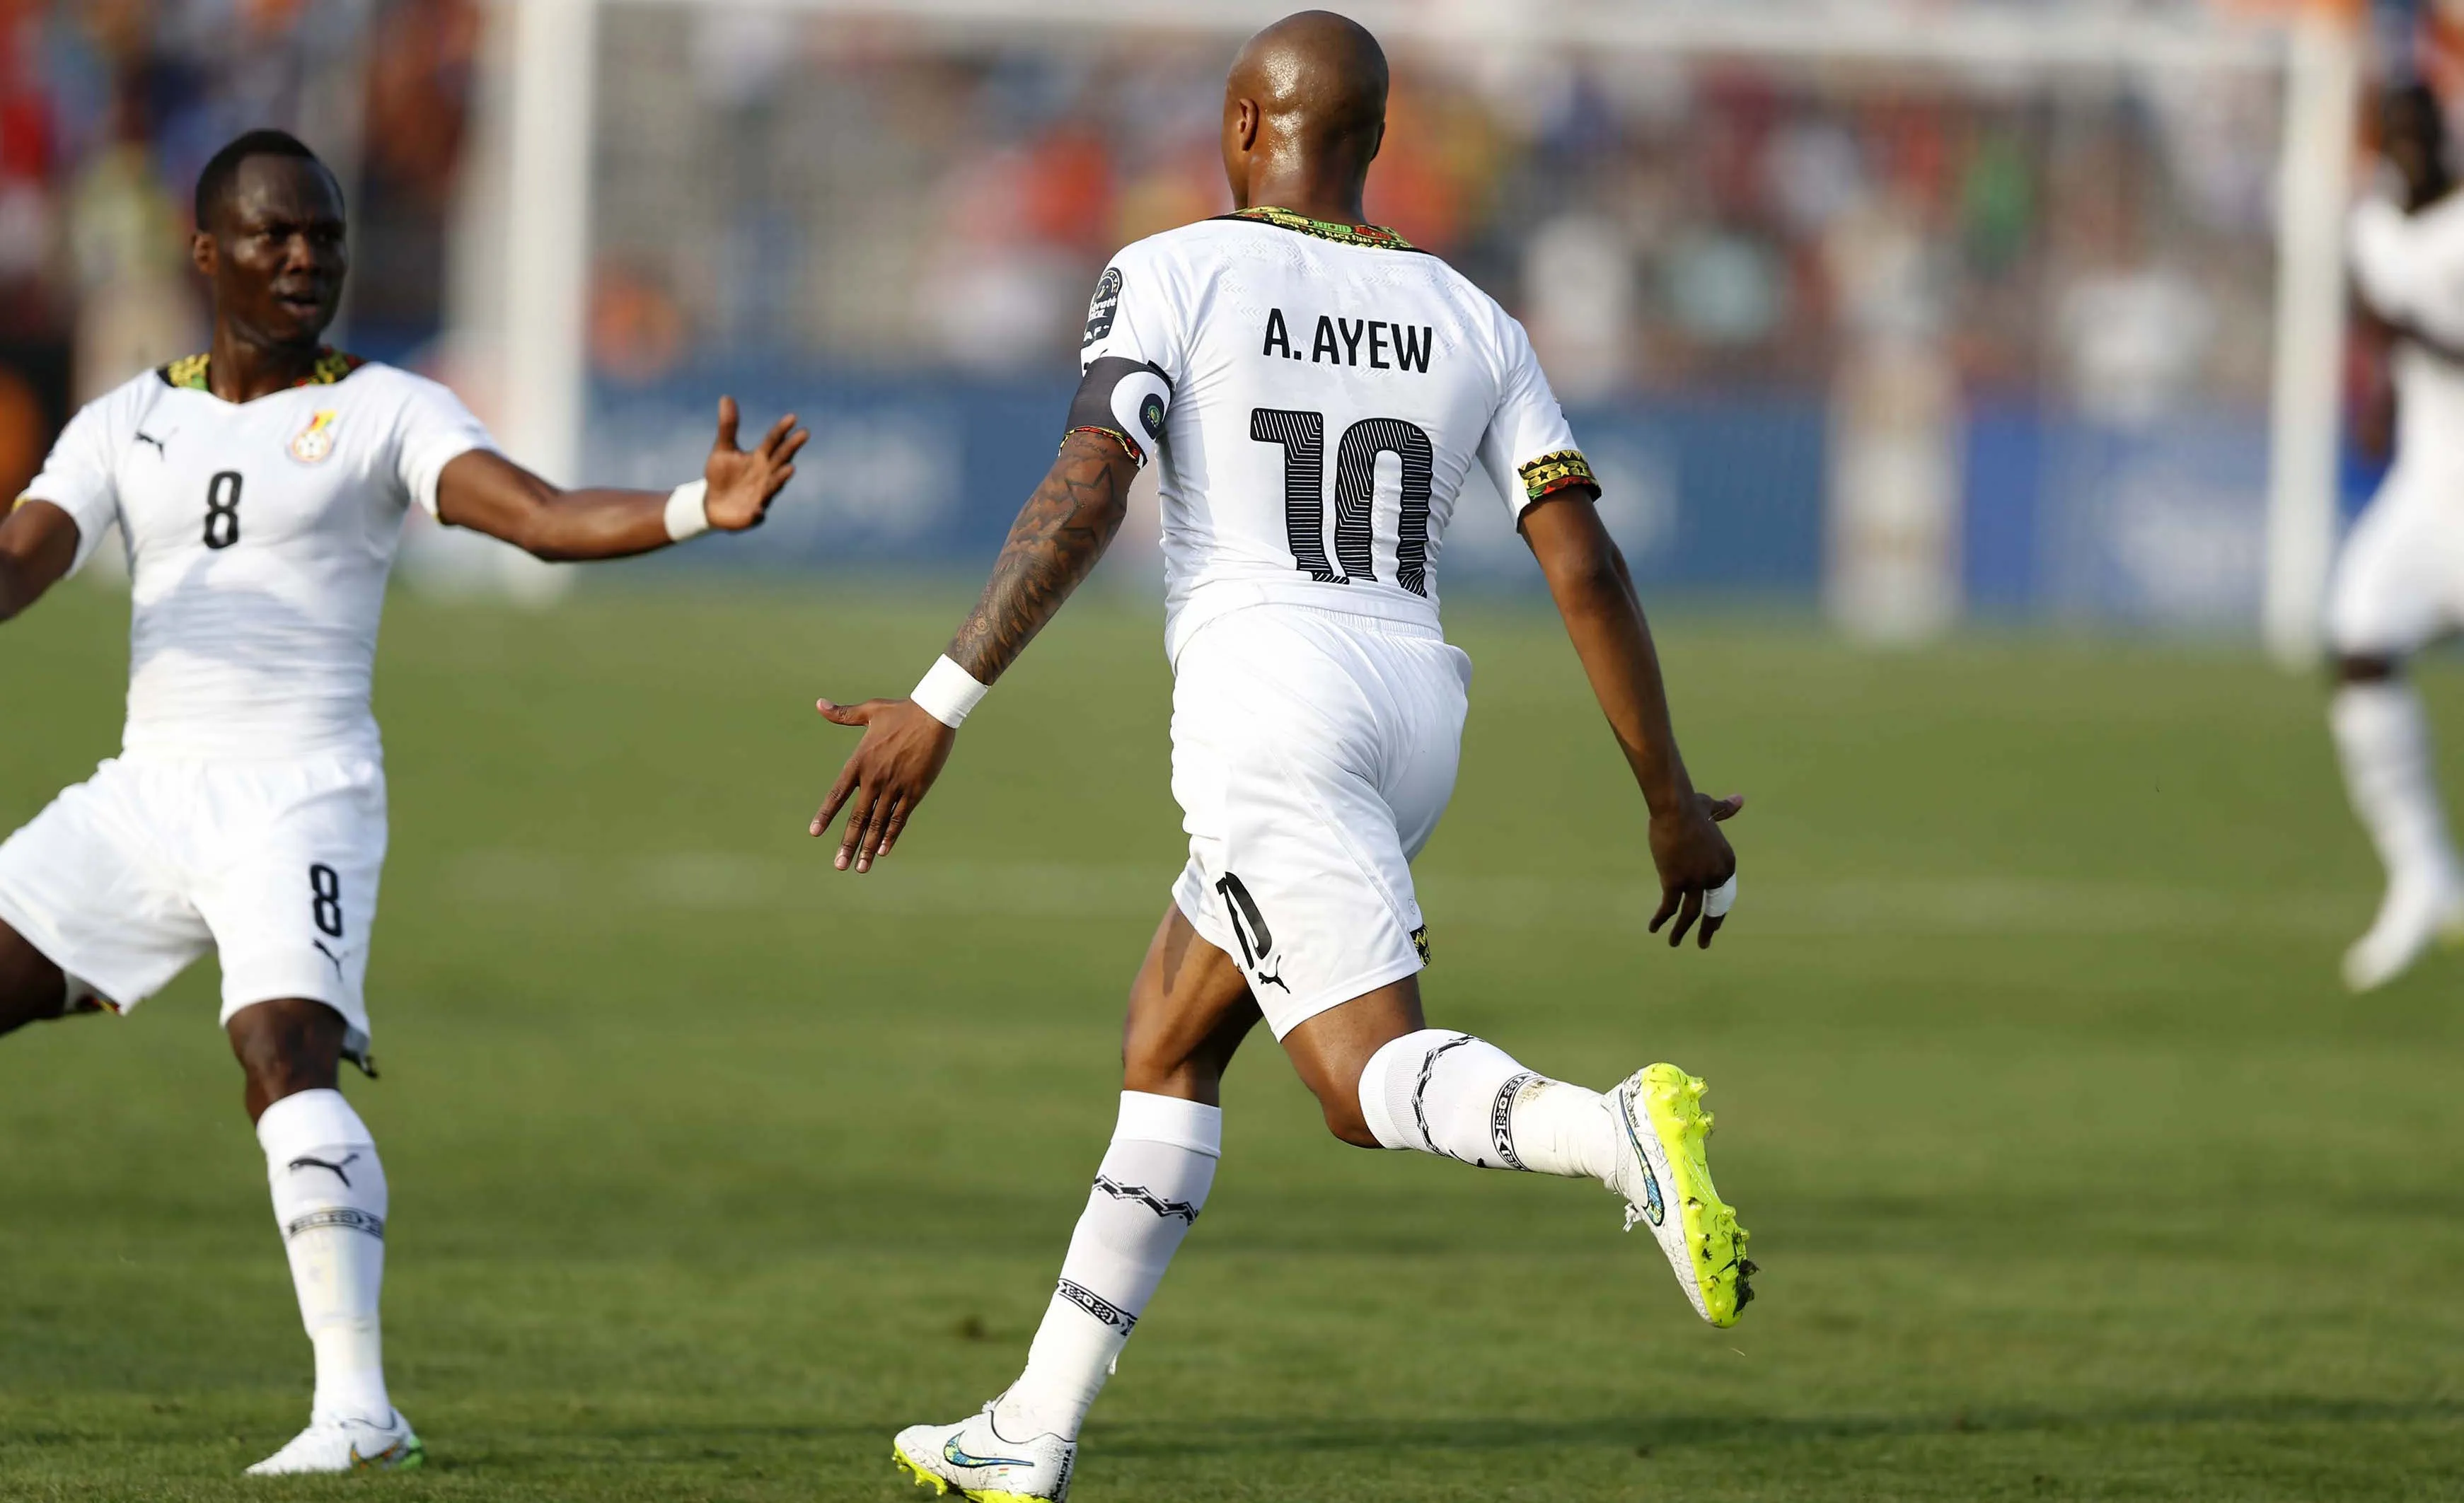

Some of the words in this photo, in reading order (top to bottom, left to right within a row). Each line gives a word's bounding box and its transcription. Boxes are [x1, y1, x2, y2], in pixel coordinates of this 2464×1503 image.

[1312, 315, 1432, 373] AYEW
[202, 470, 243, 550] 8
[1250, 407, 1433, 598] 10
[310, 861, 342, 939] 8
[1215, 871, 1272, 970] 10
